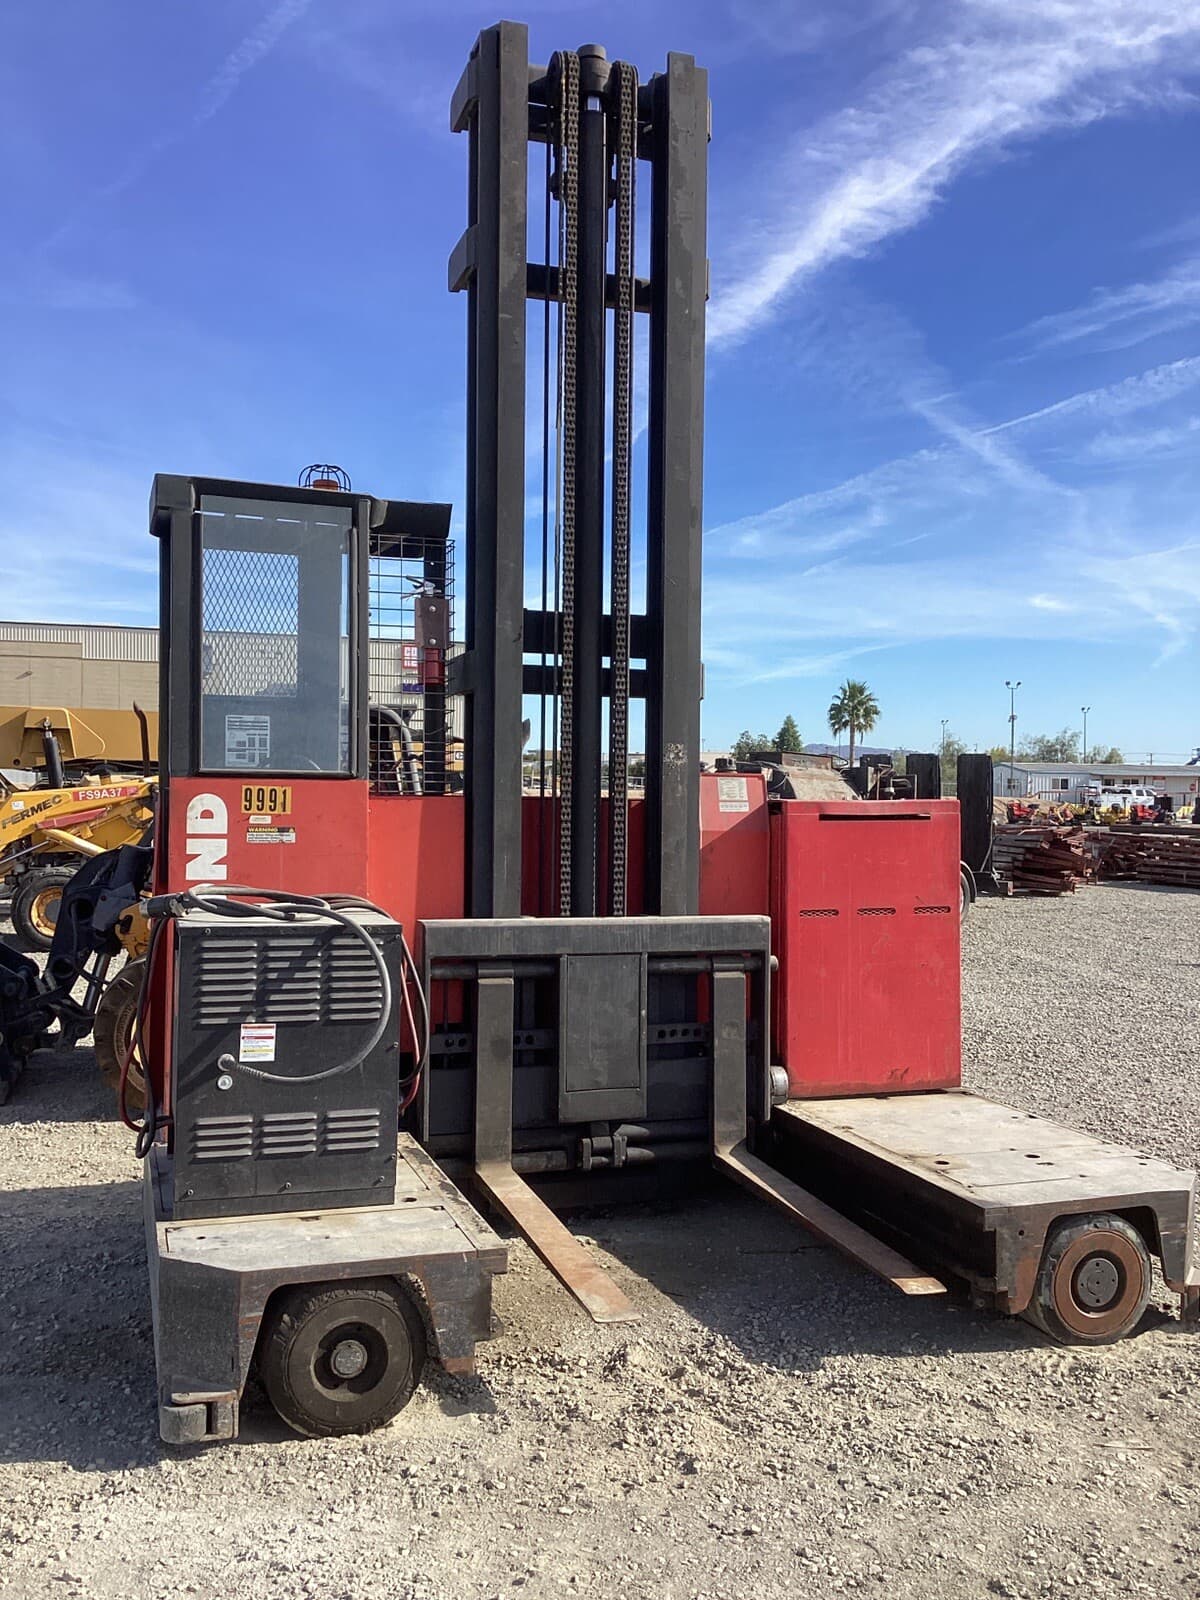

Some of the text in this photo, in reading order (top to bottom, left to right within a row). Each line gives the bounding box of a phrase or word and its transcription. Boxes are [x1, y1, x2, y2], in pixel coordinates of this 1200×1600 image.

[78, 787, 122, 801] FS9A37
[244, 787, 287, 812] 9991
[2, 794, 63, 829] FERMEC
